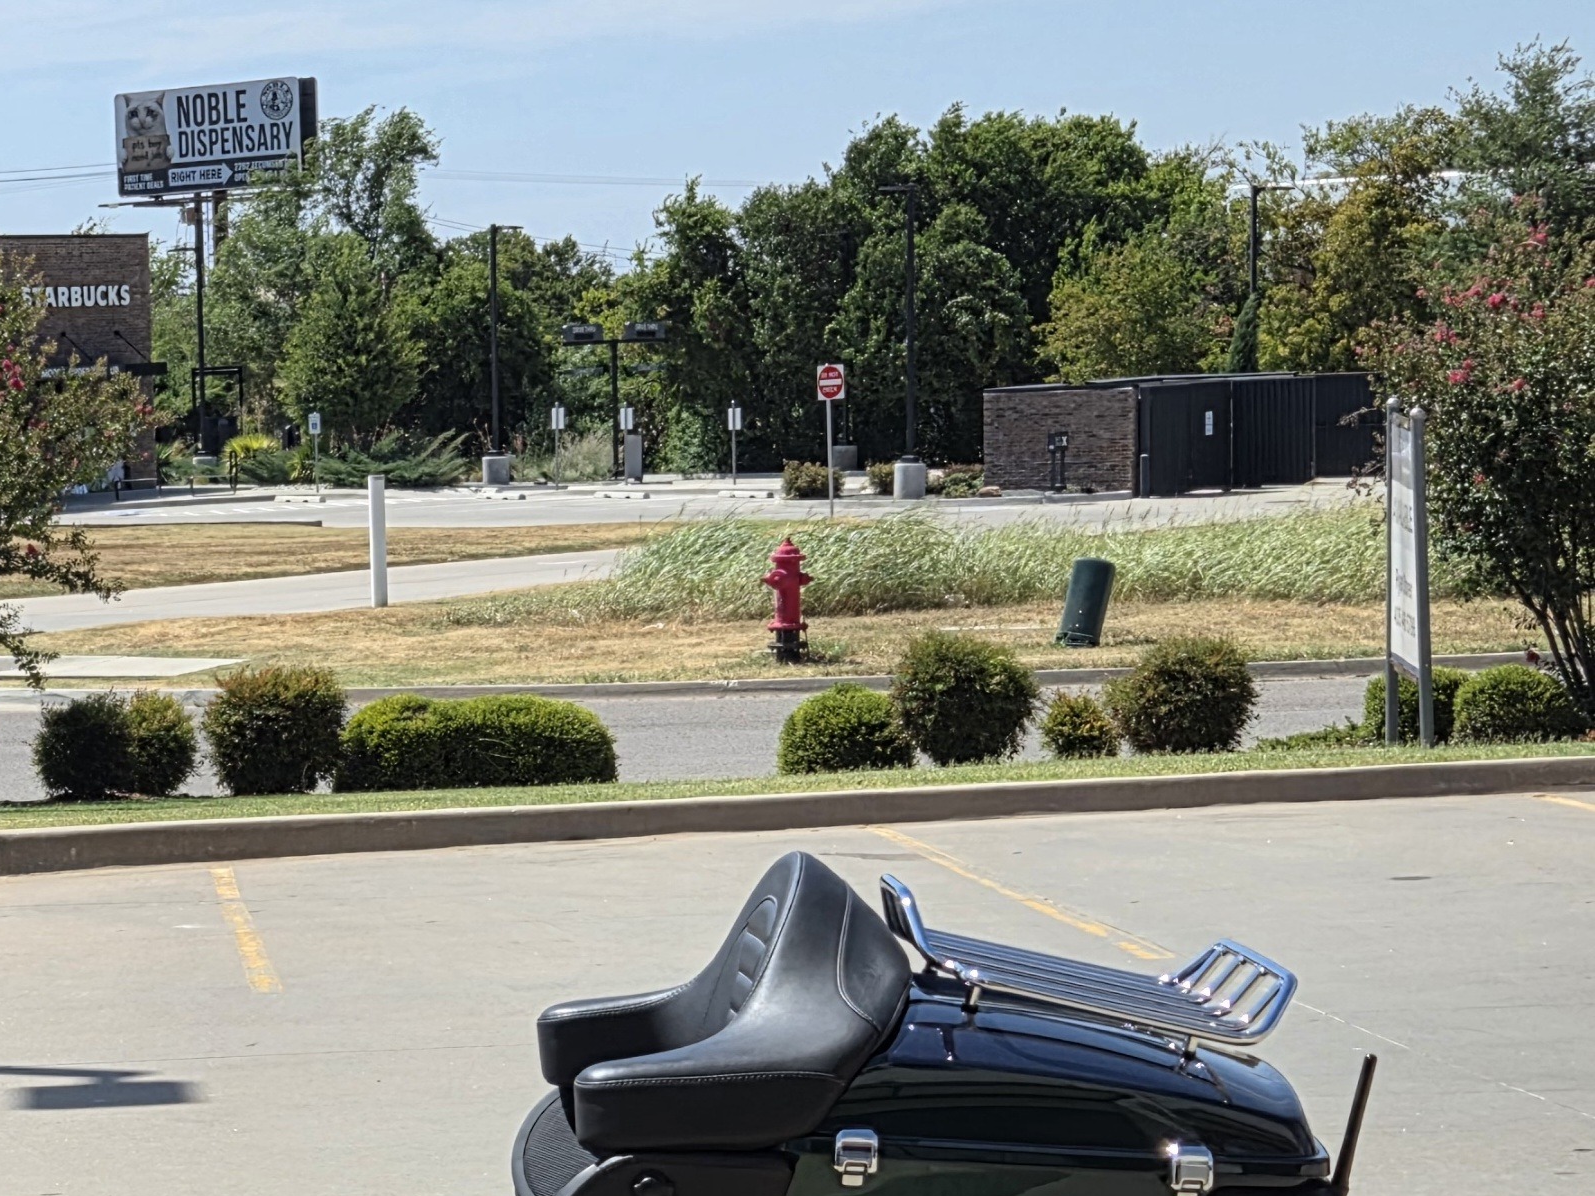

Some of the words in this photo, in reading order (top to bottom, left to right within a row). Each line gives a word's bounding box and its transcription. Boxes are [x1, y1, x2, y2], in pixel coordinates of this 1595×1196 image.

[176, 89, 248, 128] NOBLE
[178, 121, 294, 159] DISPENSARY
[171, 170, 197, 183] RIGHT
[199, 168, 223, 180] HERE
[22, 284, 131, 308] STARBUCKS
